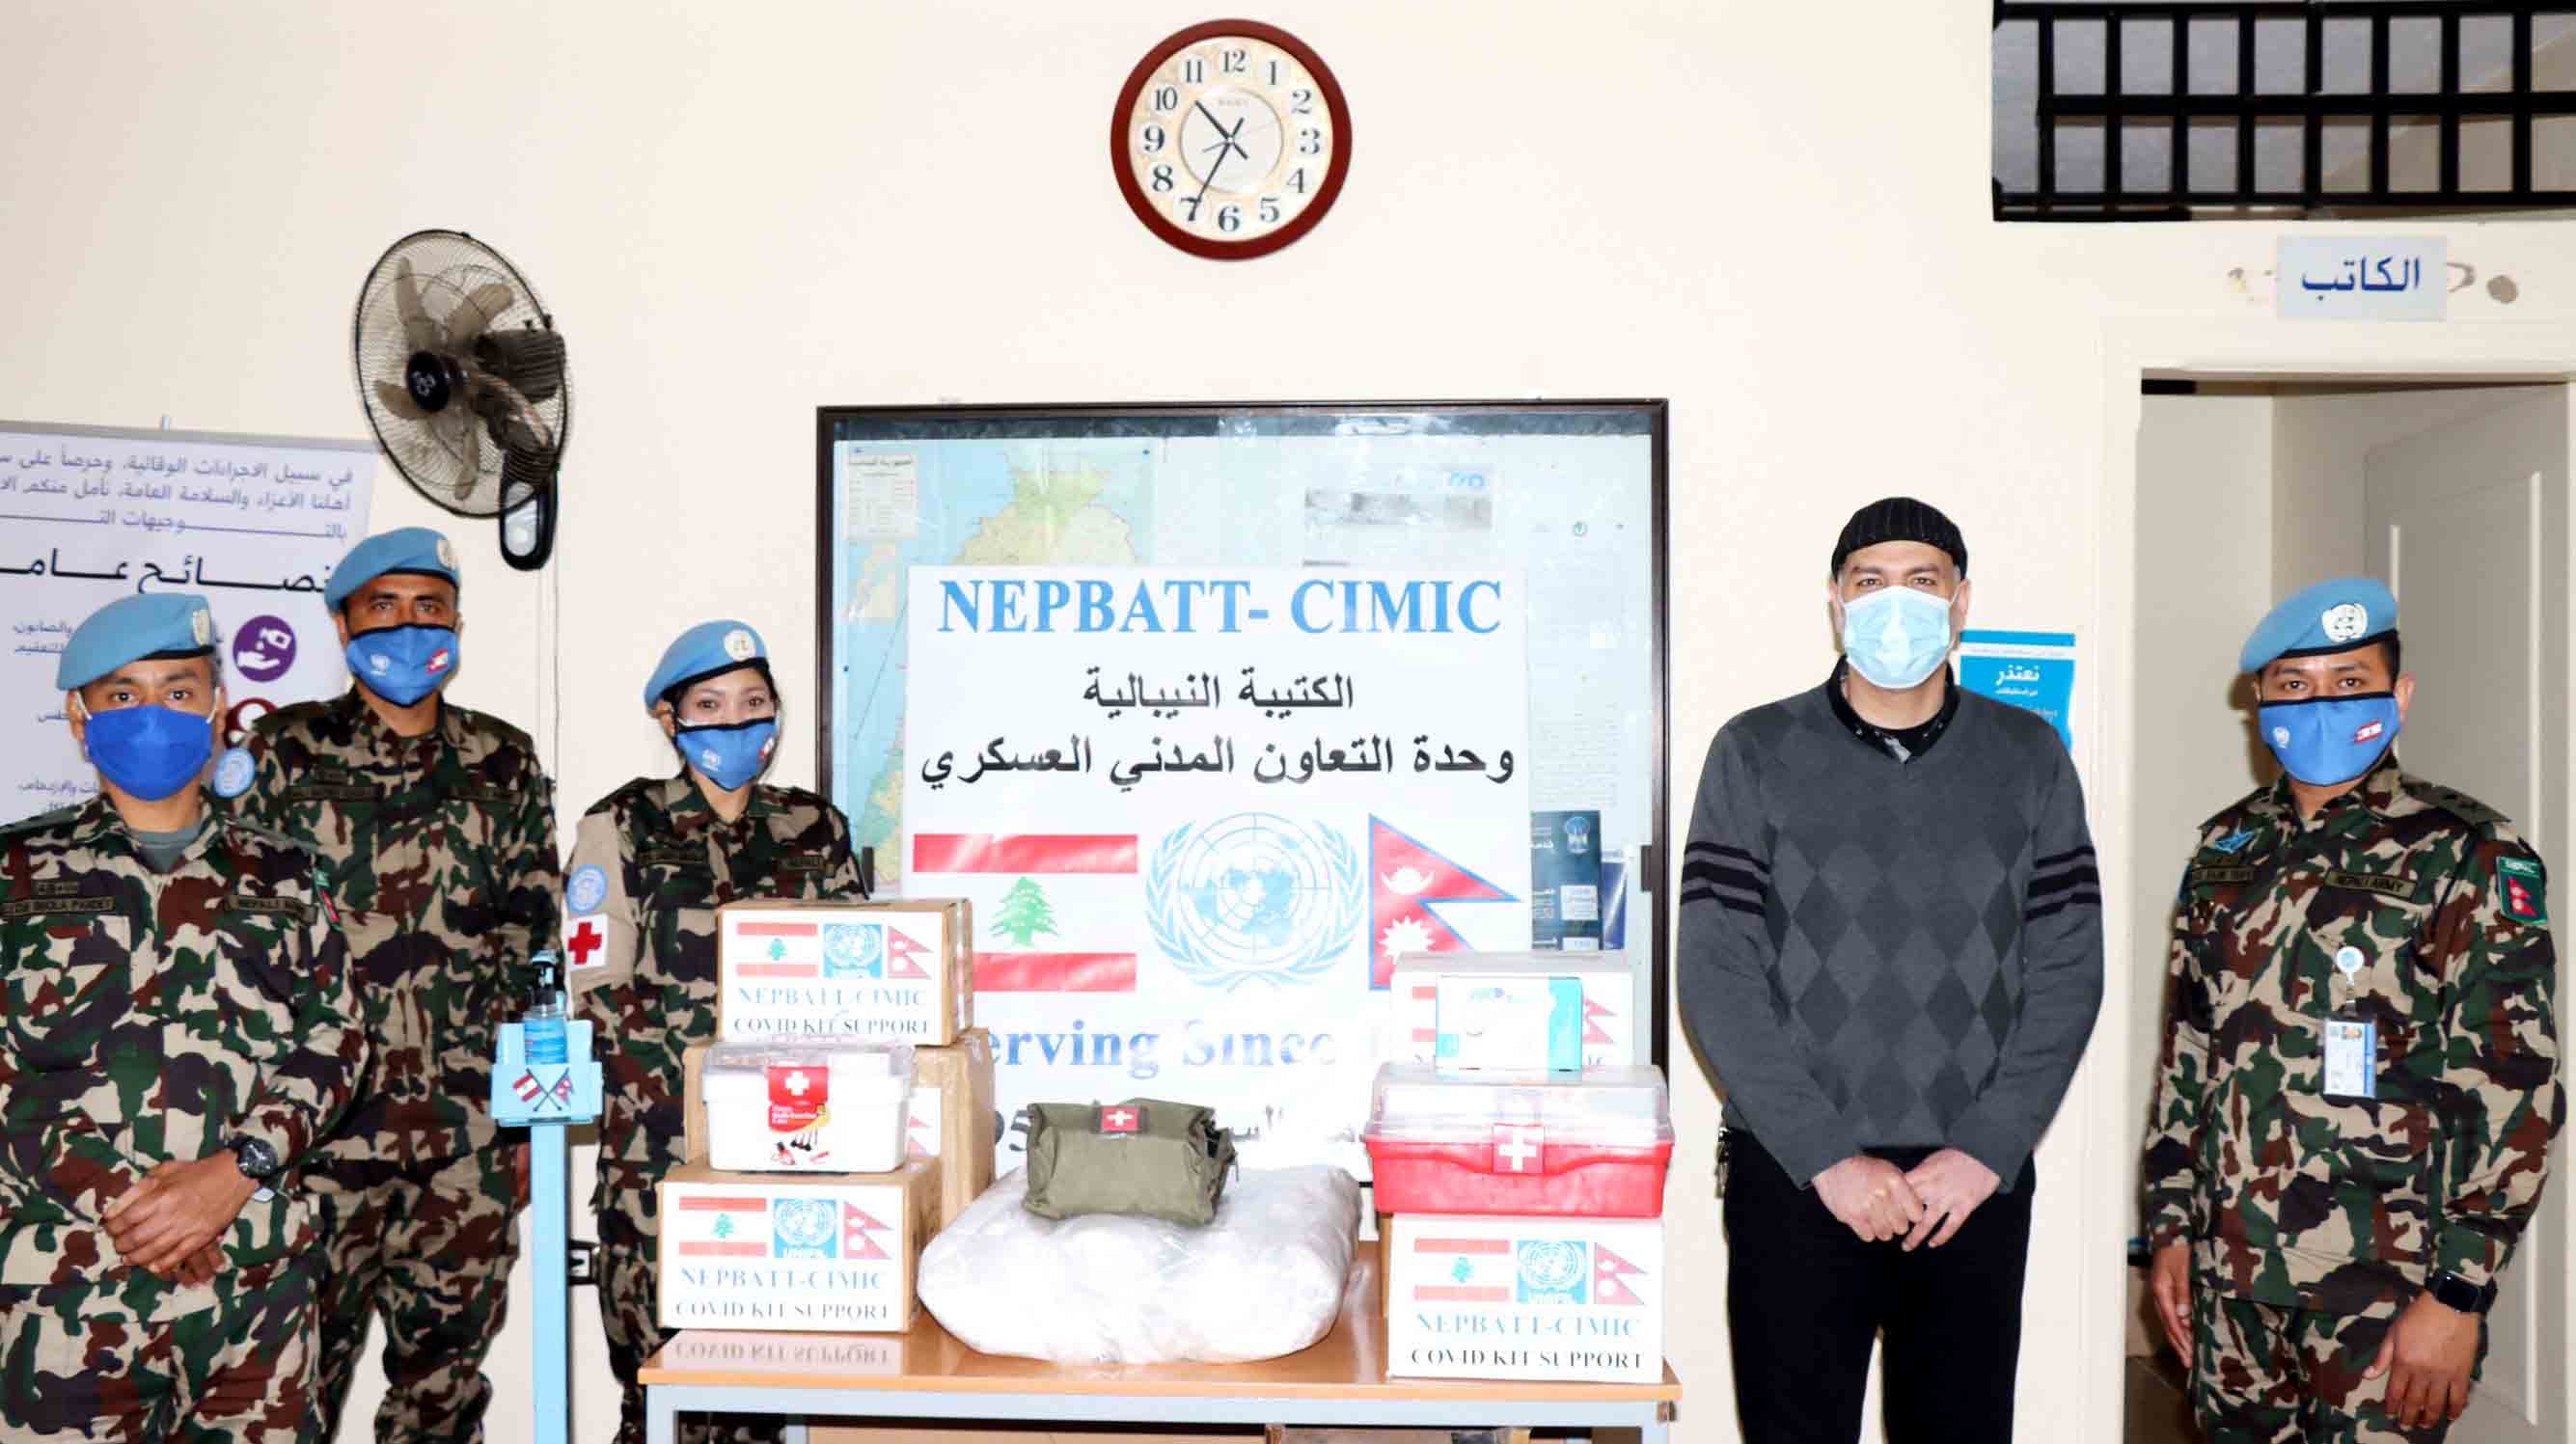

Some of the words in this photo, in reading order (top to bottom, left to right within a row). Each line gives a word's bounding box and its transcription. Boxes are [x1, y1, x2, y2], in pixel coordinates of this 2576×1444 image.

[1186, 60, 1203, 83] 11
[1223, 49, 1247, 73] 12
[1269, 61, 1277, 86] 1
[1155, 87, 1178, 111] 10
[1292, 89, 1312, 115] 2
[1143, 124, 1165, 152] 9
[1300, 128, 1321, 154] 3
[1152, 165, 1174, 192] 8
[1286, 168, 1306, 194] 4
[1181, 196, 1202, 222] 7
[1218, 205, 1241, 232] 6
[1260, 196, 1281, 223] 5
[2301, 256, 2421, 302] الكاتب
[938, 579, 1270, 634] NEPBATT-
[1290, 579, 1501, 635] CIMIC
[1082, 666, 1220, 720] النيبالية
[1238, 666, 1354, 720] الكتيبة
[920, 733, 1092, 791] العسكري
[1109, 734, 1235, 793] المدني
[1252, 733, 1394, 785] التعاون
[1413, 734, 1515, 785] وحدة
[733, 1018, 798, 1034] COVID
[803, 1019, 835, 1034] KIT
[842, 1019, 928, 1035] SUPPORT
[985, 1019, 1161, 1079] erving
[675, 1300, 745, 1318] COVID
[752, 1302, 784, 1319] KIT
[794, 1303, 888, 1320] SUPPORT
[1411, 1348, 1487, 1365] COVID
[1494, 1349, 1528, 1367] KIT
[1539, 1350, 1642, 1370] SUPPORT
